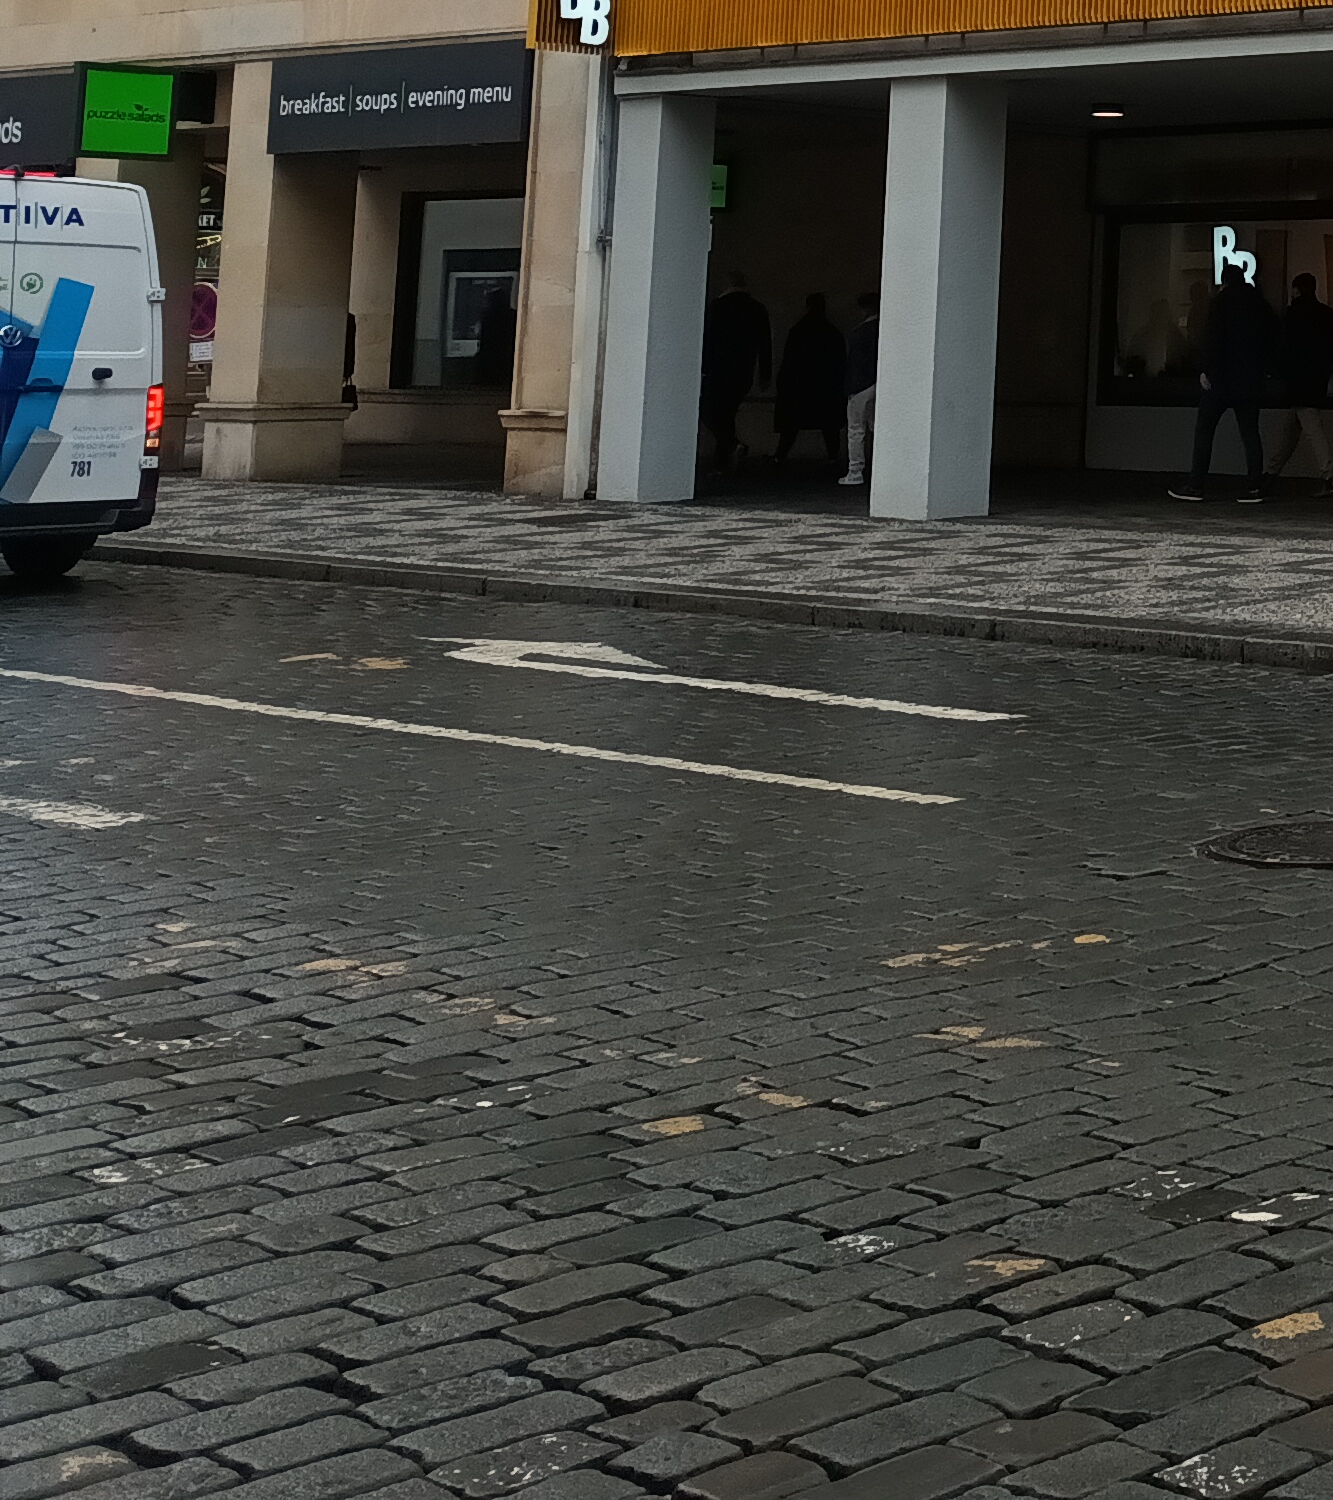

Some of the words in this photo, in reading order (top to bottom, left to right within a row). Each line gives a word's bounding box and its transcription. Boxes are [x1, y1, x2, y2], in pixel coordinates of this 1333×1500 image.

[279, 91, 346, 116] breakfast
[355, 92, 398, 114] soups
[408, 85, 466, 109] evening
[469, 85, 512, 104] menu
[86, 109, 125, 121] puzzle
[127, 107, 166, 123] salads
[0, 116, 22, 143] ds
[70, 460, 92, 478] 781
